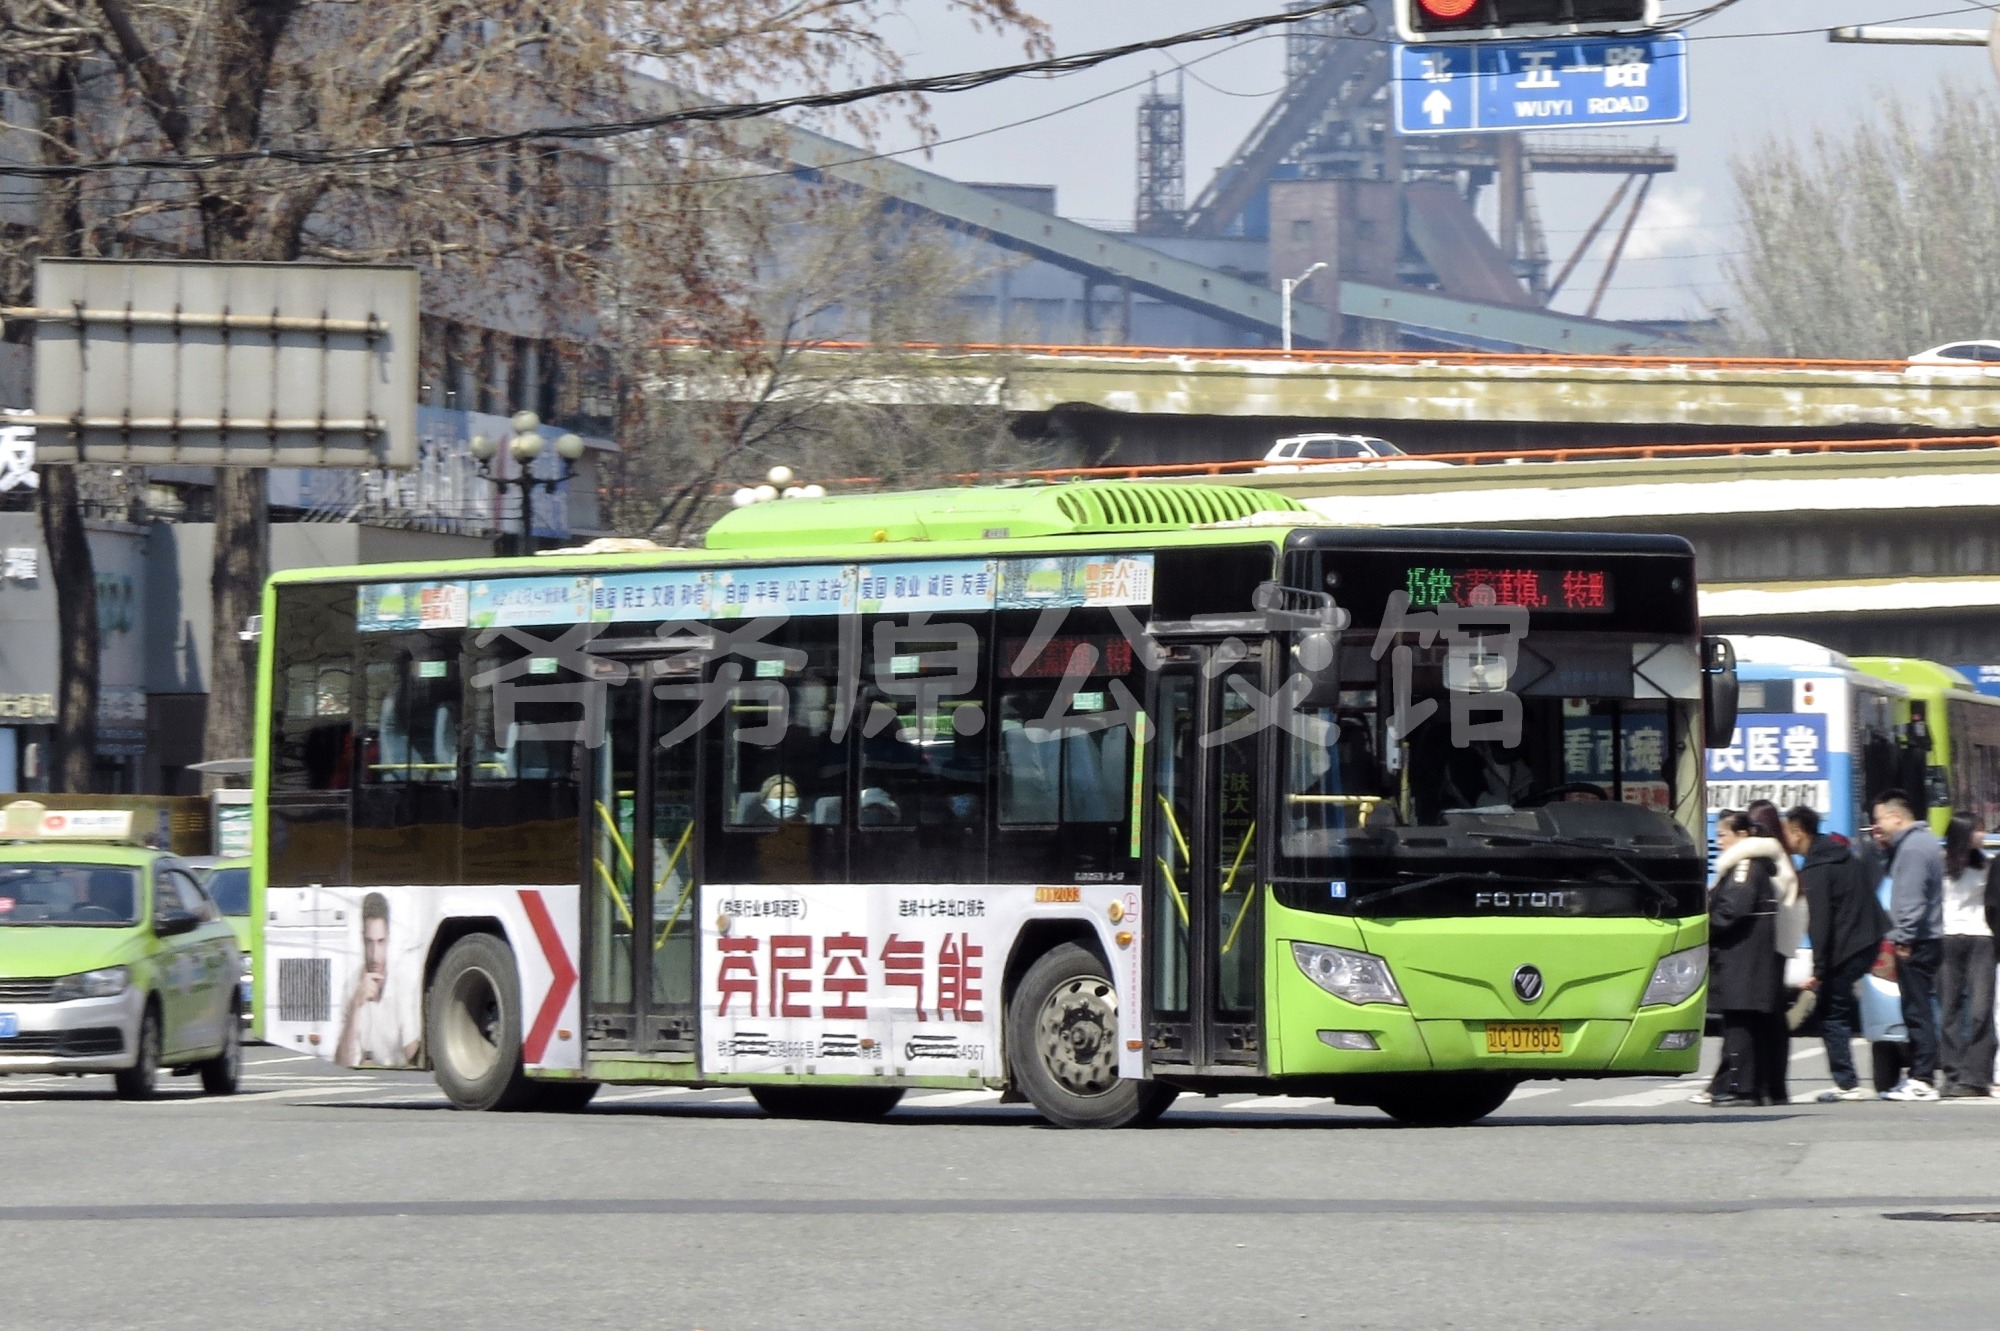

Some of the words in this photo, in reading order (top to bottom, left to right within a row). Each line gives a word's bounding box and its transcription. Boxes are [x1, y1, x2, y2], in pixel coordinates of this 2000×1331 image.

[1515, 46, 1649, 89] 五一路
[1514, 99, 1572, 118] WUYI
[1587, 96, 1650, 115] ROAD
[622, 586, 645, 608] 民主
[652, 585, 675, 607] 文明
[725, 583, 750, 604] 自由
[755, 581, 780, 603] 平等
[786, 579, 810, 602] 公正
[816, 578, 842, 601] 法治
[928, 573, 953, 597] 诚信
[961, 572, 988, 596] 友善
[1475, 892, 1564, 908] FOTON
[717, 931, 984, 1022] 芬尼空气能
